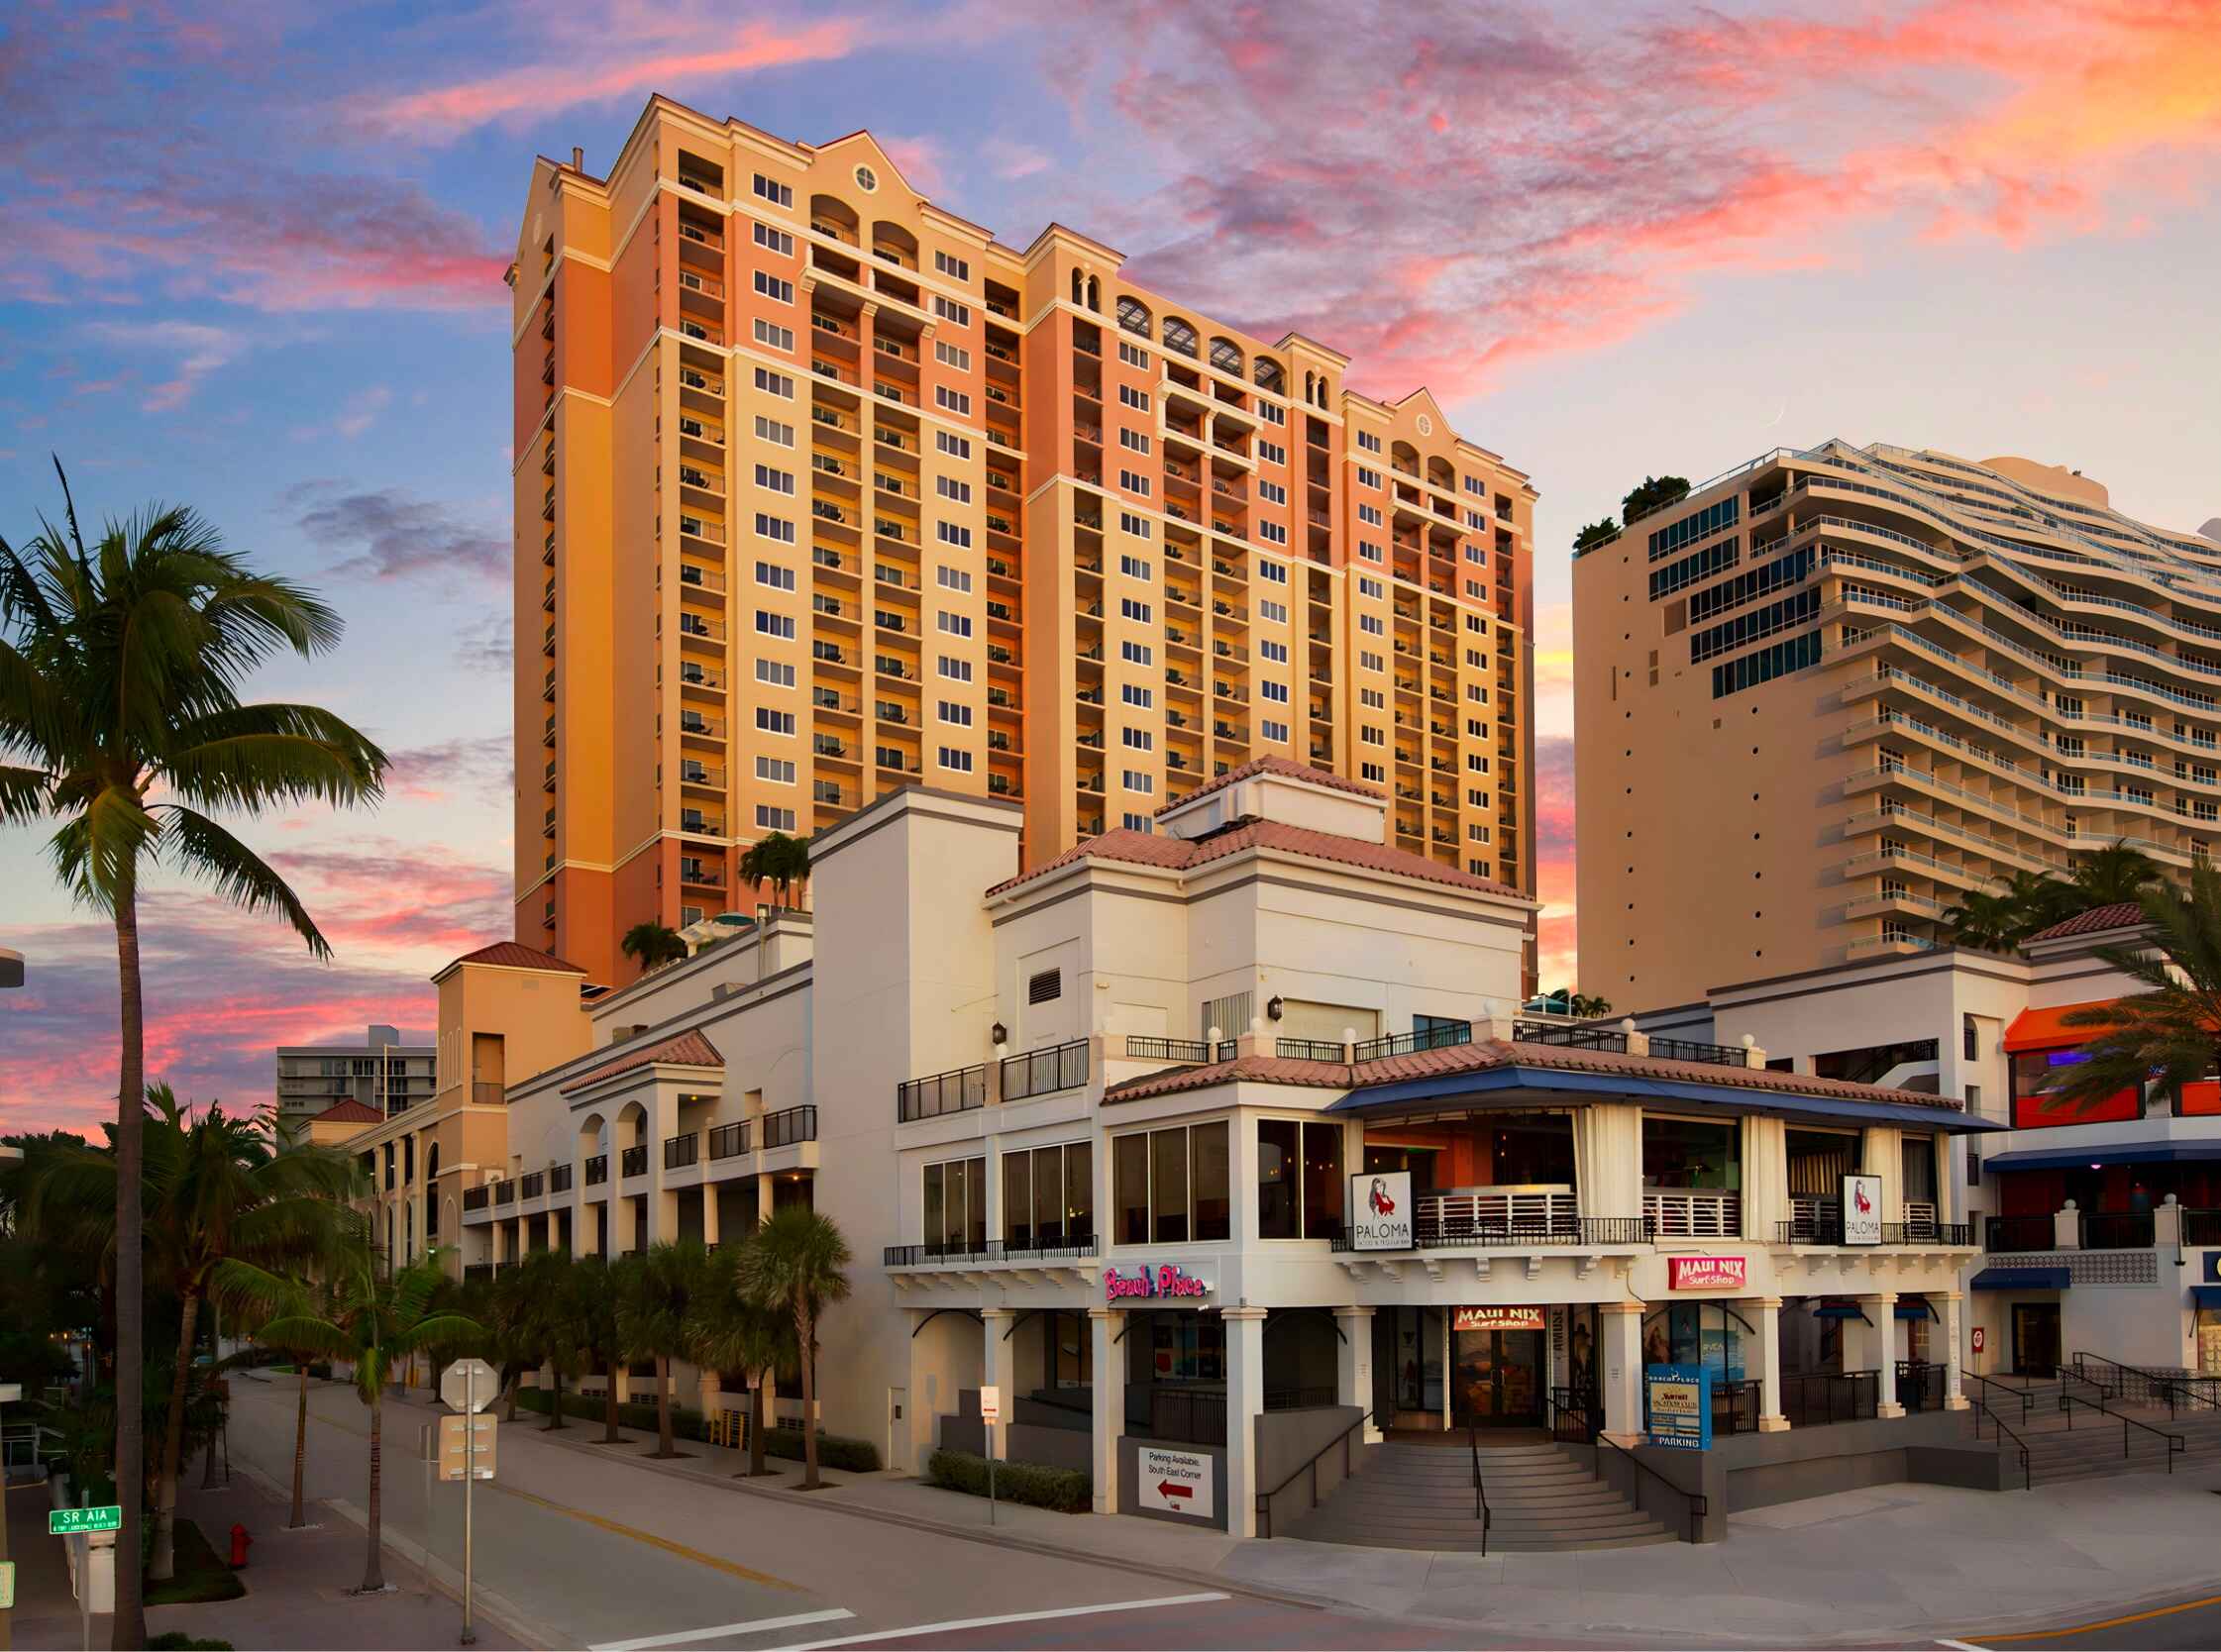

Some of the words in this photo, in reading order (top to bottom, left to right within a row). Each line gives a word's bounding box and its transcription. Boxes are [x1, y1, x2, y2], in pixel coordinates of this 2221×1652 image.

[1356, 1223, 1409, 1239] PALOMA
[1679, 1260, 1715, 1281] MAUI
[1719, 1260, 1744, 1279] NIX
[1103, 1263, 1151, 1300] Beach
[1157, 1264, 1206, 1299] Place
[1457, 1308, 1504, 1324] MAUI
[1509, 1308, 1540, 1322] NIX
[1552, 1308, 1564, 1351] AMUSE
[1659, 1437, 1700, 1448] PARKING
[1149, 1452, 1171, 1464] Parking
[1149, 1464, 1166, 1475] South
[1167, 1467, 1180, 1476] East
[1181, 1469, 1202, 1480] Corner
[63, 1511, 79, 1523] SR
